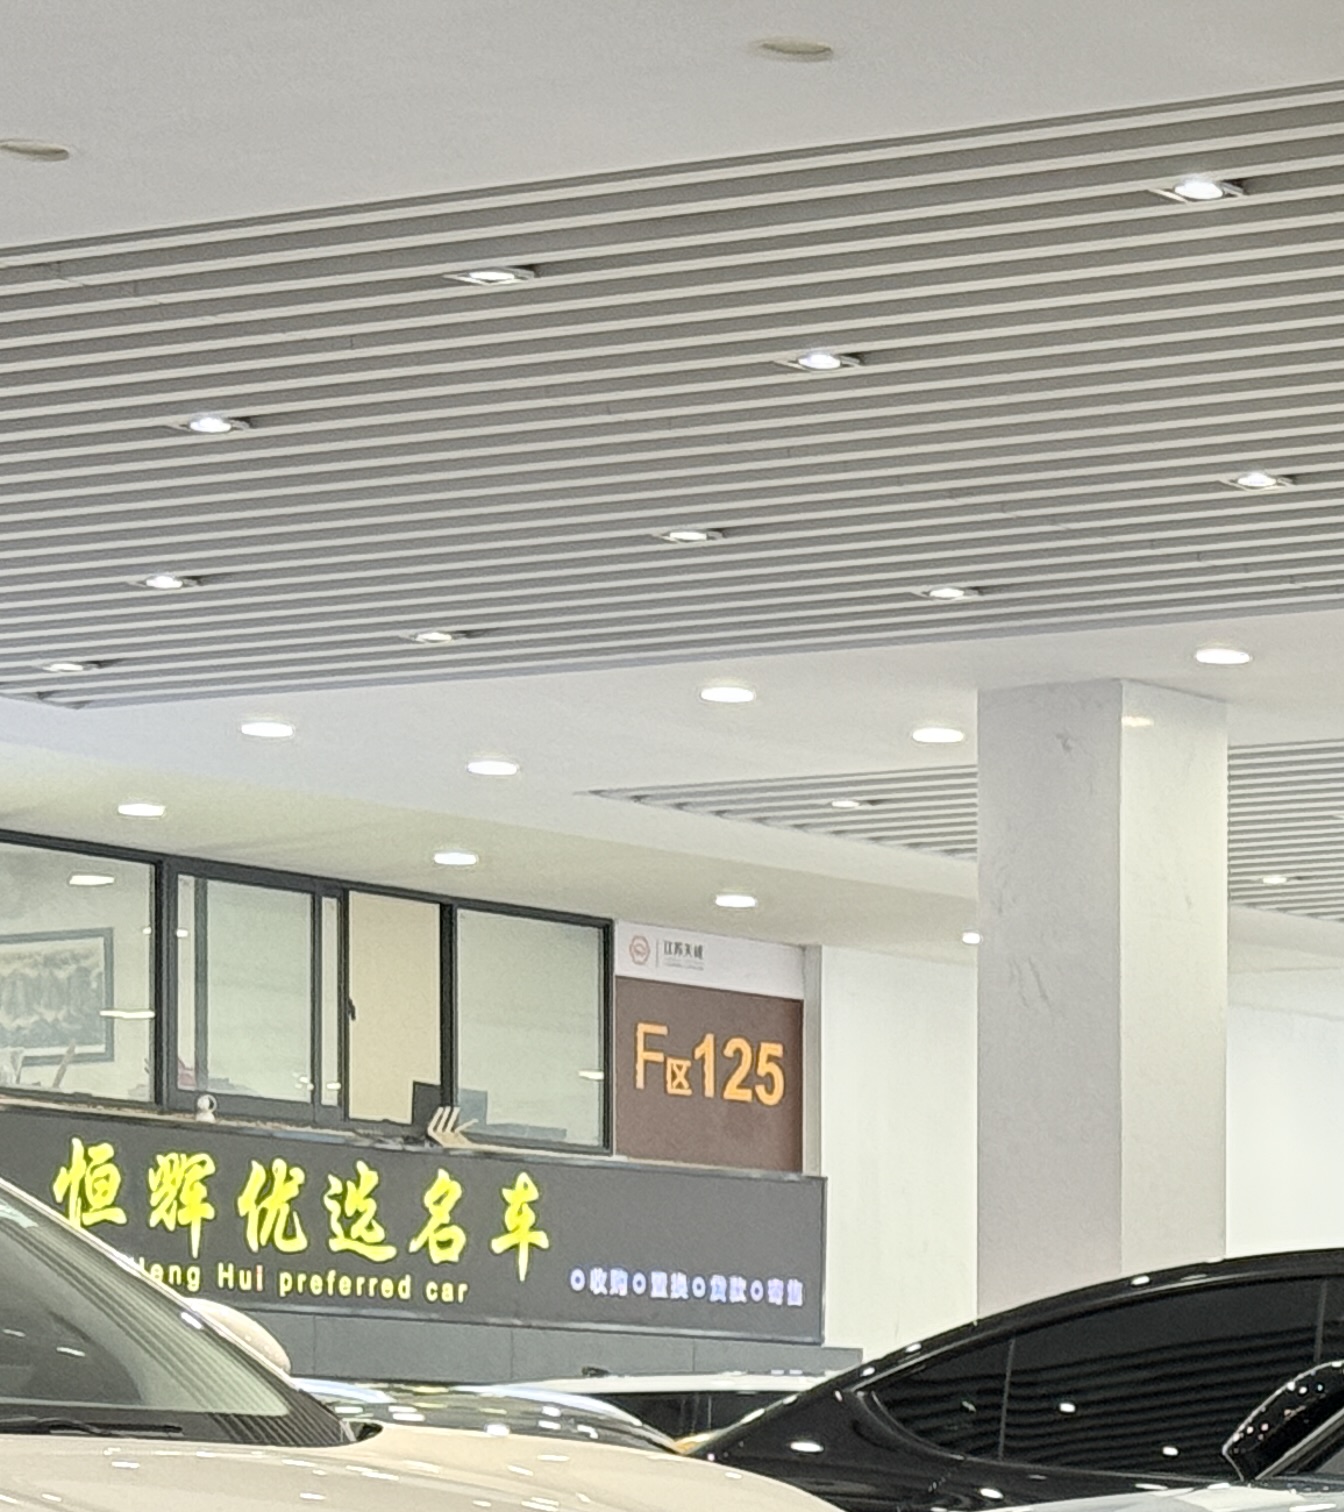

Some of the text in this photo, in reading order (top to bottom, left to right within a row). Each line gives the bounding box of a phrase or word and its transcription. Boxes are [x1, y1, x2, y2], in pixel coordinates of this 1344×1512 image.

[635, 1022, 785, 1106] F区125
[53, 1137, 549, 1282] 恒辉优选名车
[217, 1262, 264, 1292] Hui
[279, 1268, 411, 1299] preferred
[425, 1279, 469, 1303] car
